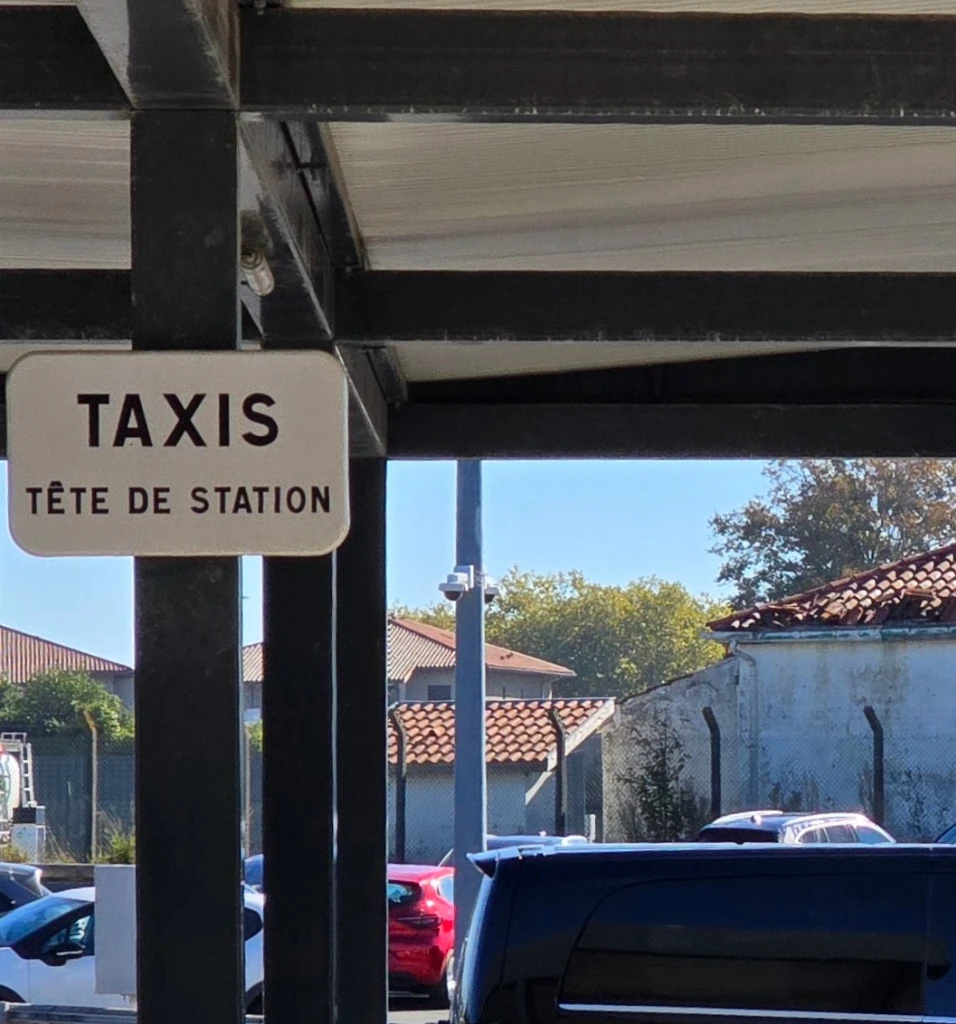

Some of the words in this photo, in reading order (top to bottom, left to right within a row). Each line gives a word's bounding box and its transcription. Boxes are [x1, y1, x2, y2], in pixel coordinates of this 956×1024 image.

[77, 393, 279, 447] TAXIS
[26, 481, 109, 515] TÊTE
[128, 487, 171, 514] DE
[190, 486, 330, 514] STATION
